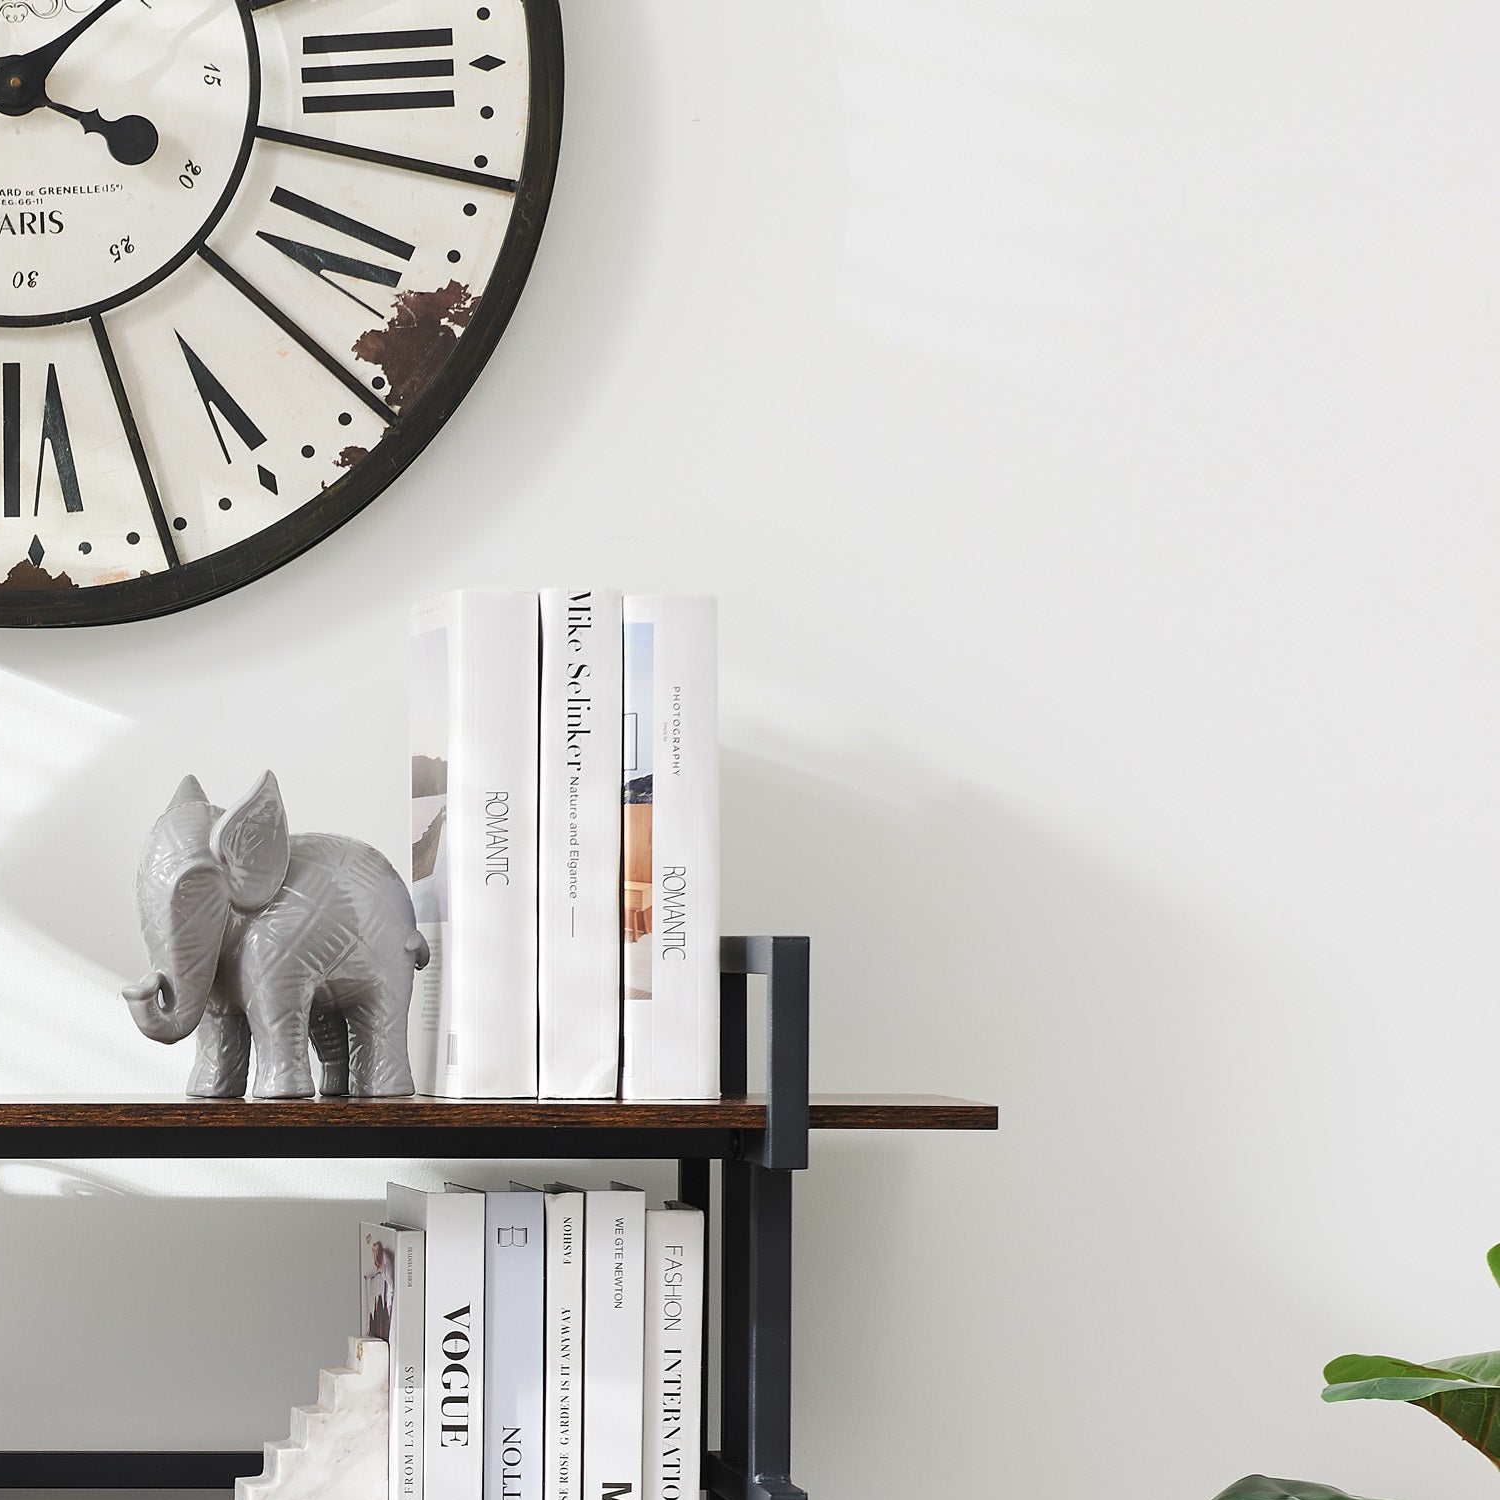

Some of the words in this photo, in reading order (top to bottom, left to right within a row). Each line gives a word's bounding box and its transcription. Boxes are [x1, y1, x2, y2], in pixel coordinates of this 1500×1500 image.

[204, 64, 221, 86] 15
[179, 159, 201, 189] 20
[110, 235, 134, 263] 25
[13, 271, 38, 288] 30
[567, 589, 592, 652] Mike
[567, 664, 591, 771] Selinker
[672, 687, 681, 776] PHOTOGRAPHY
[570, 777, 579, 819] Nature
[486, 792, 509, 885] ROMANTIC
[570, 823, 579, 845] and
[567, 851, 579, 899] Elgance
[662, 867, 686, 960] ROMANTIC
[563, 1217, 572, 1264] FASHION
[615, 1218, 624, 1234] WE
[615, 1238, 623, 1259] GTE
[614, 1263, 623, 1308] NEWTON
[664, 1246, 683, 1330] FASHION
[561, 1308, 570, 1360] ANYWAY
[404, 1366, 414, 1413] VEGAS
[441, 1302, 470, 1447] VOGUE
[561, 1364, 570, 1375] IT
[561, 1381, 569, 1390] IS
[405, 1421, 413, 1446] LAS
[560, 1396, 569, 1445] GARDEN
[405, 1455, 413, 1493] FROM
[560, 1454, 568, 1483] ROSE
